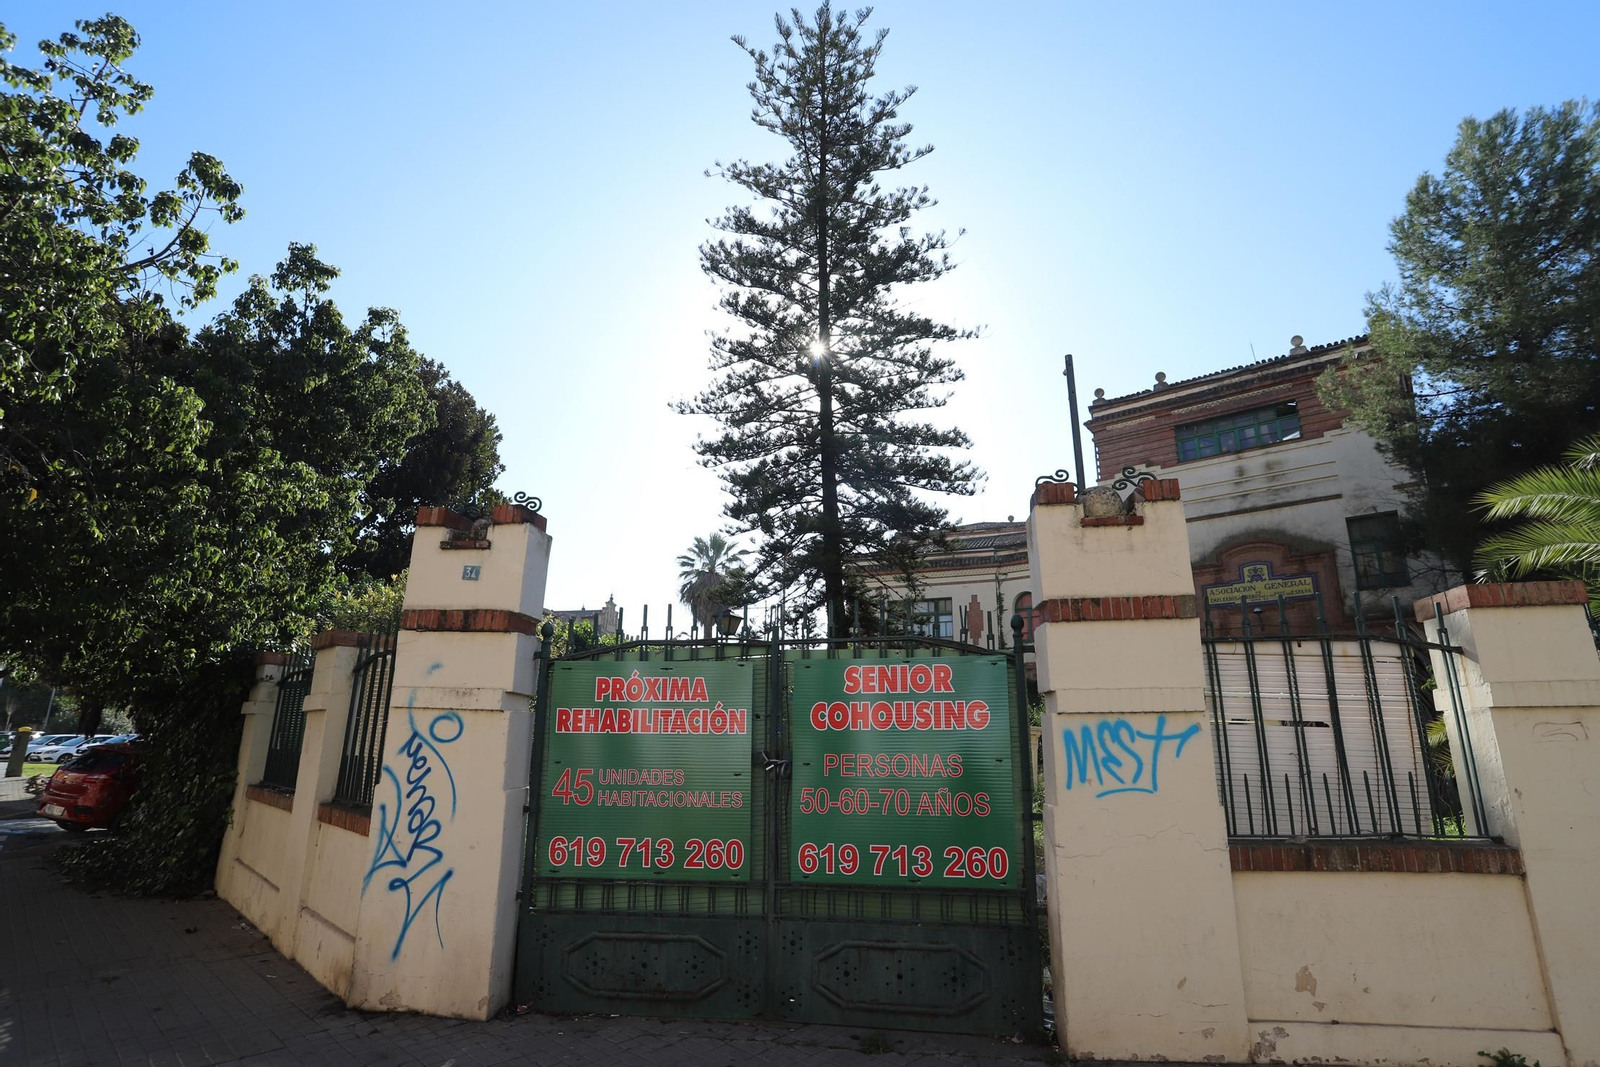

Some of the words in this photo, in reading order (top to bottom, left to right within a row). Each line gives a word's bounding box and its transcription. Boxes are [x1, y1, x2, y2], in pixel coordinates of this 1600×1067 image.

[1264, 579, 1310, 590] GENERAL
[595, 670, 709, 702] PRÓXIMA
[844, 664, 954, 694] SENIOR
[556, 701, 747, 734] REHABILITACIÓN
[810, 700, 990, 731] COHOUSING
[823, 754, 963, 777] PERSONAS
[552, 768, 594, 806] 45
[599, 769, 685, 786] UNIDADES
[597, 790, 743, 808] HABITACIONALES
[800, 788, 910, 815] 50-60-70
[916, 788, 991, 816] AÑOS
[549, 836, 606, 867] 619
[616, 838, 675, 868] 713
[684, 838, 744, 869] 260
[798, 842, 859, 875] 619
[870, 844, 933, 877] 713
[943, 846, 1009, 879] 260
